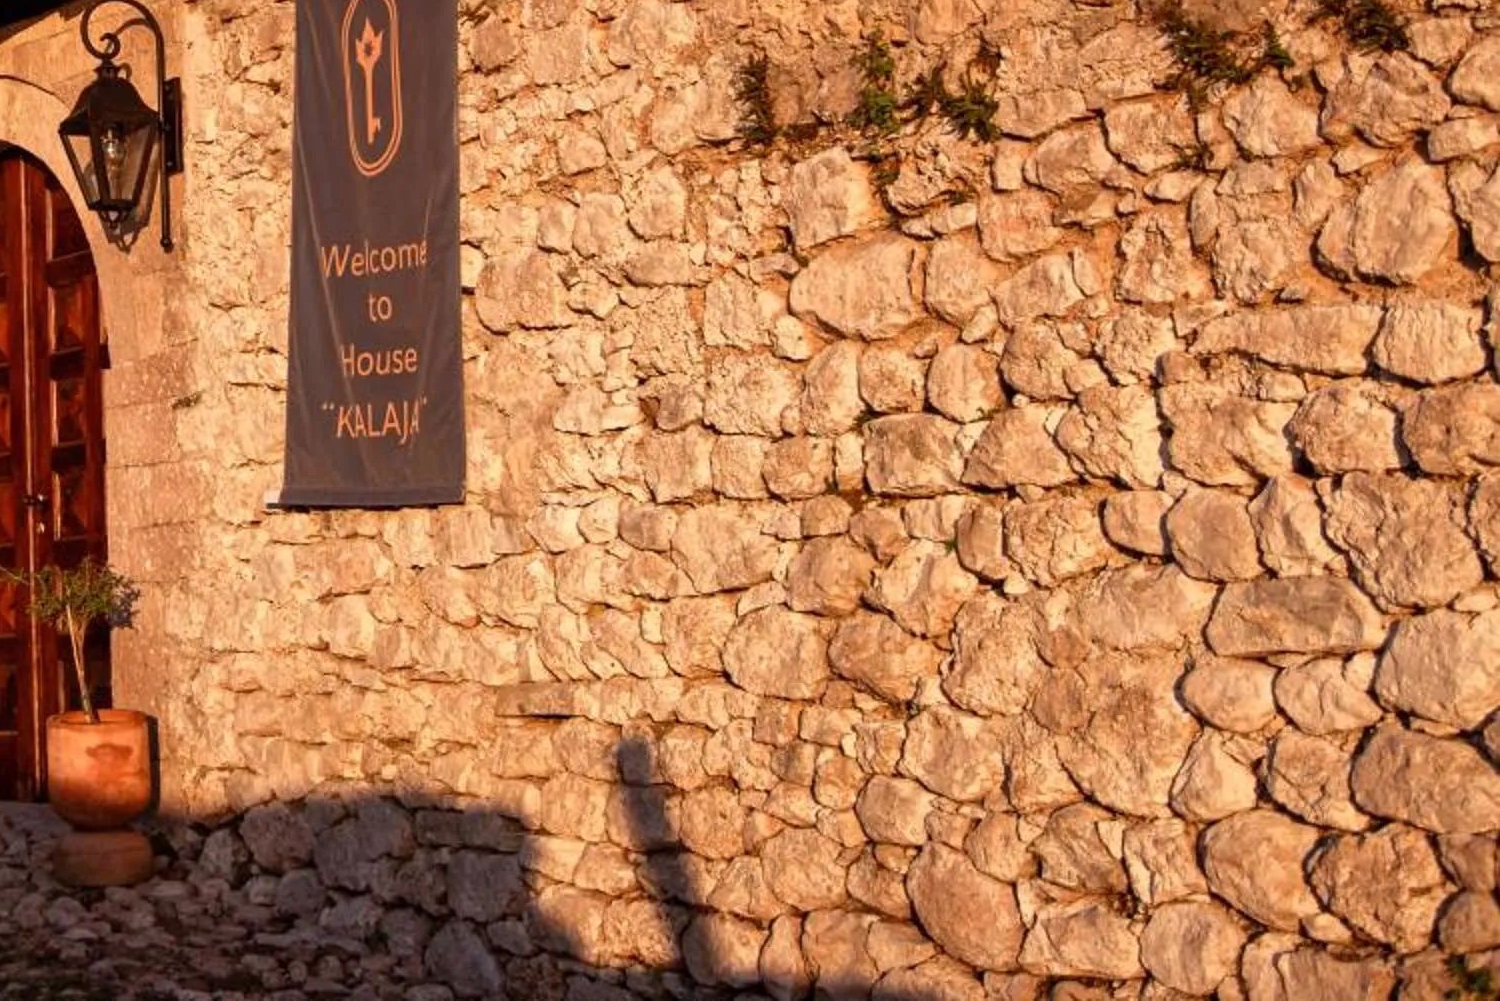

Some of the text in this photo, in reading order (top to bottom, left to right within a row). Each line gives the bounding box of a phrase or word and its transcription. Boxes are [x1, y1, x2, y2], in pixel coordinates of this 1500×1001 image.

[321, 239, 427, 278] Welcome
[368, 293, 393, 322] to
[340, 343, 419, 377] House
